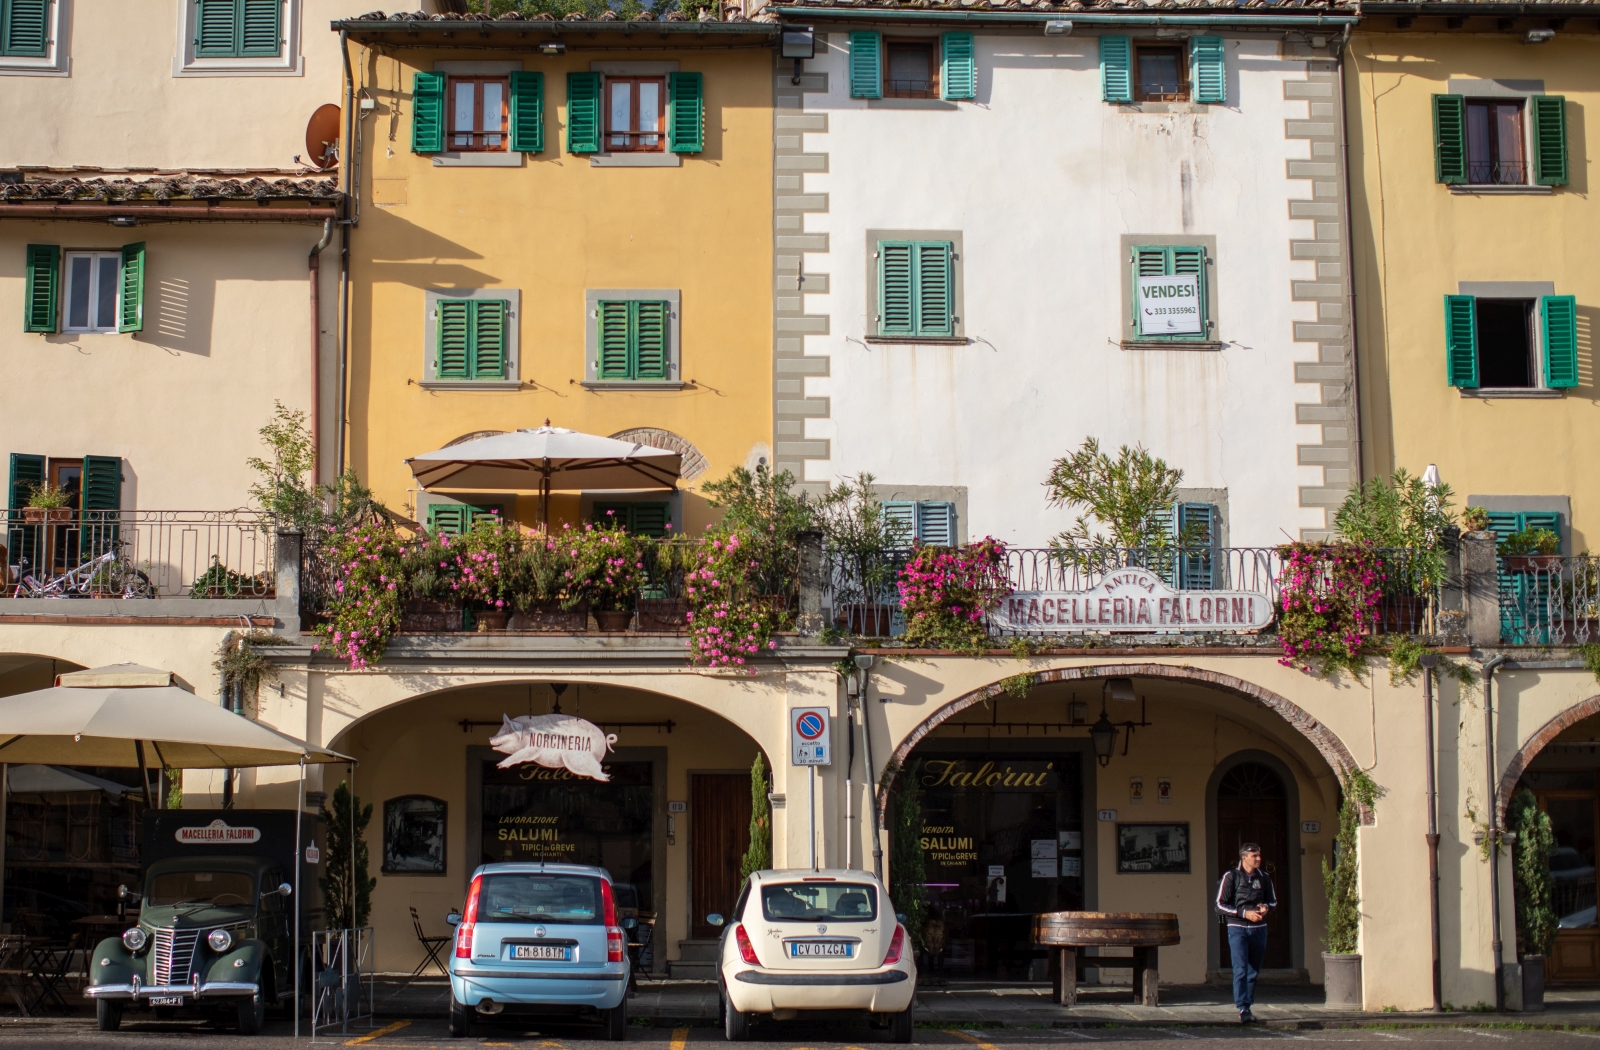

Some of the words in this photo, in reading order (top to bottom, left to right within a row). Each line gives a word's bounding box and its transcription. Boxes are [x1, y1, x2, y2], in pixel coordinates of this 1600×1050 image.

[1142, 285, 1194, 298] VENDESI
[1154, 307, 1167, 315] 333
[1168, 307, 1196, 315] 3355962
[1103, 573, 1156, 594] ANTICA
[1008, 597, 1153, 625] MACELLERIA
[1158, 597, 1255, 625] FALORNI
[529, 732, 592, 752] NORCINERIA
[519, 763, 615, 781] Falo
[921, 759, 1054, 787] Falorni
[498, 816, 559, 824] LAVORAZIONE
[1101, 811, 1112, 819] 71
[922, 826, 954, 834] VENDITA
[1305, 823, 1316, 831] 72
[182, 829, 224, 840] MACELLERIA
[226, 829, 255, 840] FALORNI
[498, 828, 558, 841] SALUMI
[550, 843, 575, 851] GREVE
[920, 837, 973, 850] SALUMI
[956, 852, 978, 860] GREVE
